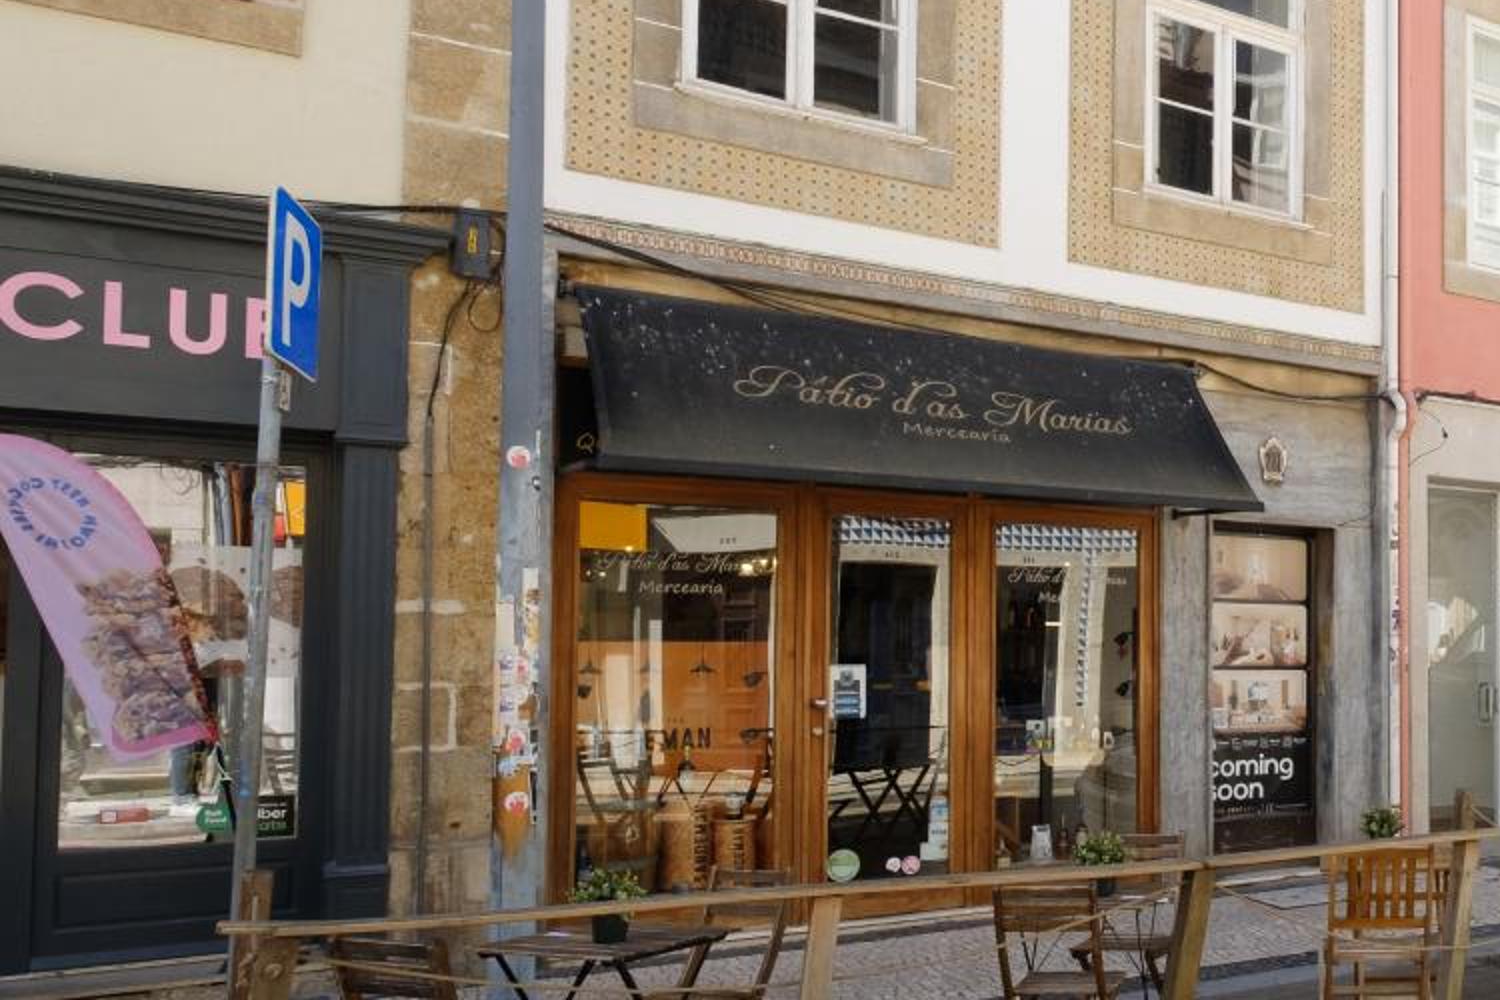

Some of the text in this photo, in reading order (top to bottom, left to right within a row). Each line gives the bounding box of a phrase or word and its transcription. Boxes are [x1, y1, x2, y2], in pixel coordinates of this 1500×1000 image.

[282, 211, 311, 347] P
[733, 365, 886, 409] Pátio
[983, 391, 1133, 435] Marias
[903, 422, 1011, 443] Mercearia
[638, 580, 724, 595] Mercearia
